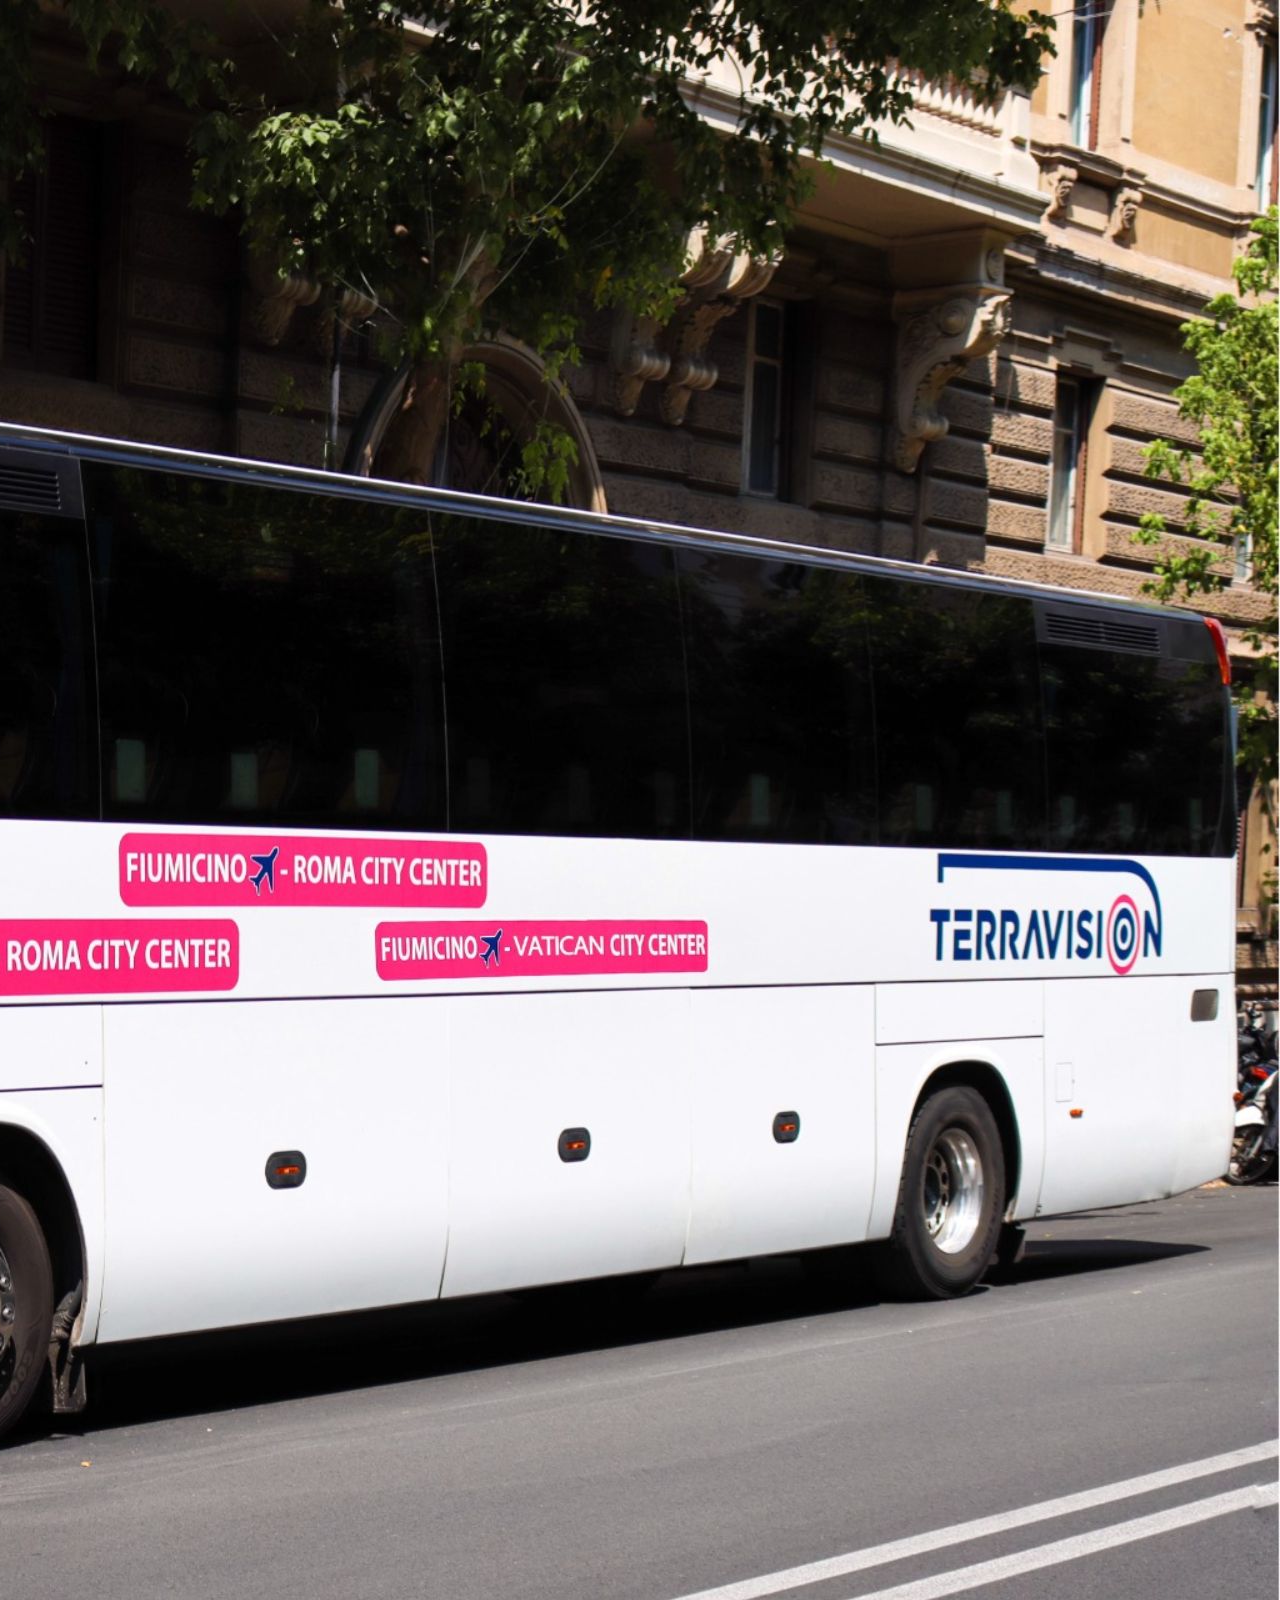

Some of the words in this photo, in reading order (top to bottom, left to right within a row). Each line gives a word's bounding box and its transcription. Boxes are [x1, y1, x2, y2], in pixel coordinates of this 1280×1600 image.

[126, 852, 247, 883] FIUMICINO
[293, 855, 357, 884] ROMA
[360, 856, 405, 886] CITY
[408, 857, 482, 887] CENTER
[380, 936, 478, 962] FIUMICINO
[609, 934, 645, 957] CITY
[648, 933, 706, 956] CENTER
[929, 893, 1163, 975] TERRAVISION
[6, 939, 82, 971] ROMA
[86, 938, 140, 970] CITY
[144, 938, 231, 969] CENTER
